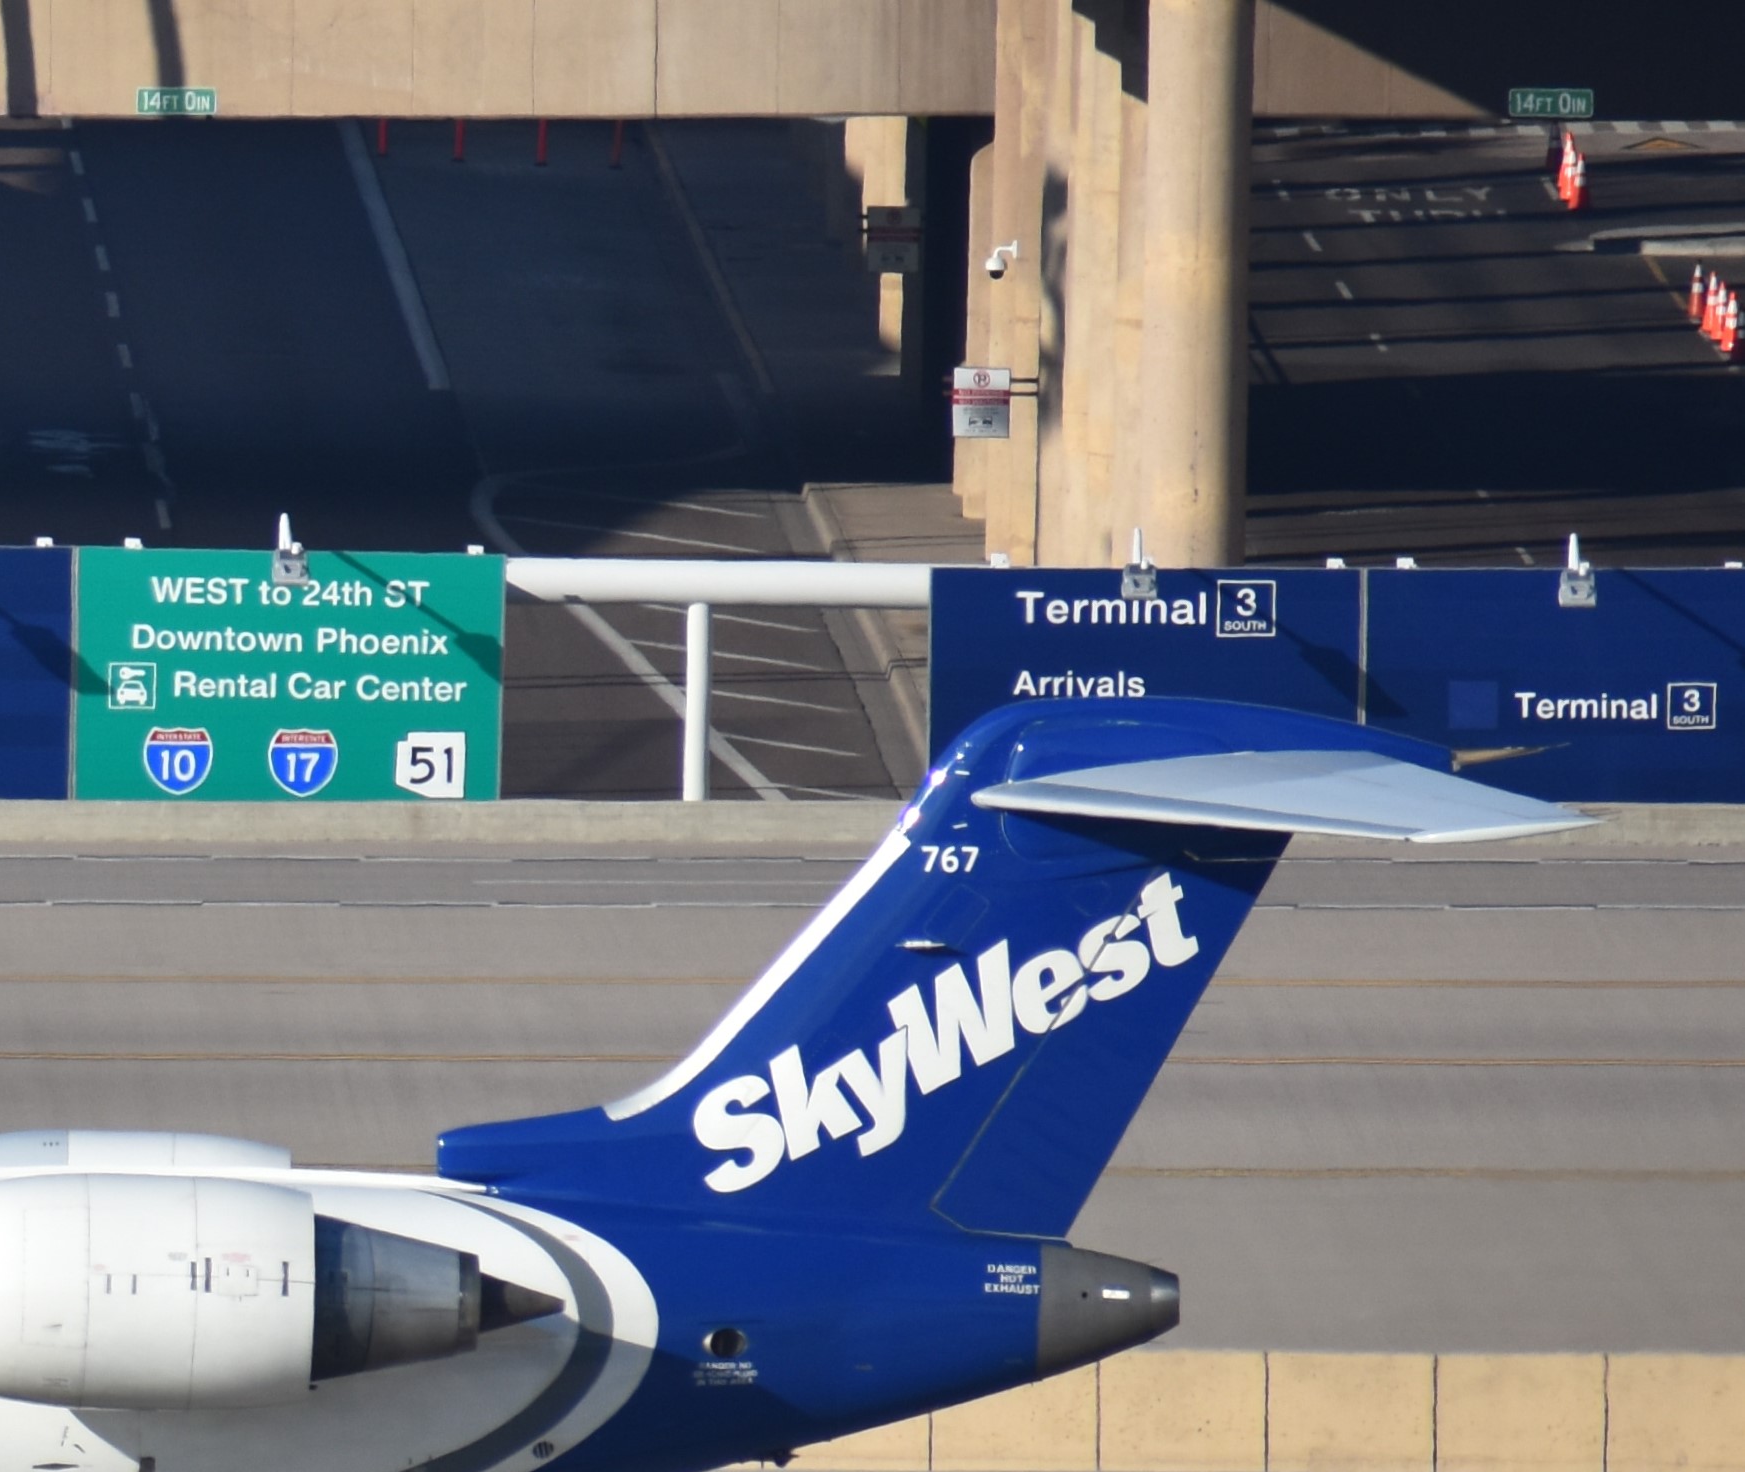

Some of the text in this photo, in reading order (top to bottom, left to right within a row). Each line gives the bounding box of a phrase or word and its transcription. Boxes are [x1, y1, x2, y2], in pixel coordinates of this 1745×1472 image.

[142, 91, 179, 111] 14FT
[1516, 93, 1553, 113] 14FT
[1325, 187, 1491, 202] ONLY
[151, 576, 430, 608] WEST to 24th ST
[1016, 588, 1256, 625] Terminal 3
[1224, 620, 1267, 632] SOUTH
[132, 624, 449, 656] Downtown Phoenix
[173, 671, 467, 702] Rental Car Center
[1013, 670, 1146, 698] Arrivals
[1515, 690, 1701, 719] Terminal 3
[1672, 715, 1710, 725] SOUTH
[156, 732, 202, 741] INTERSTATE
[281, 735, 326, 743] INTERSTATE
[160, 750, 196, 782] 10
[286, 751, 320, 783] 17
[409, 746, 455, 783] 51
[921, 846, 979, 873] 767
[693, 872, 1199, 1193] SkyWest
[987, 1264, 1037, 1274] DANGER
[1000, 1274, 1024, 1283] HOT
[984, 1283, 1040, 1294] EXHAUST
